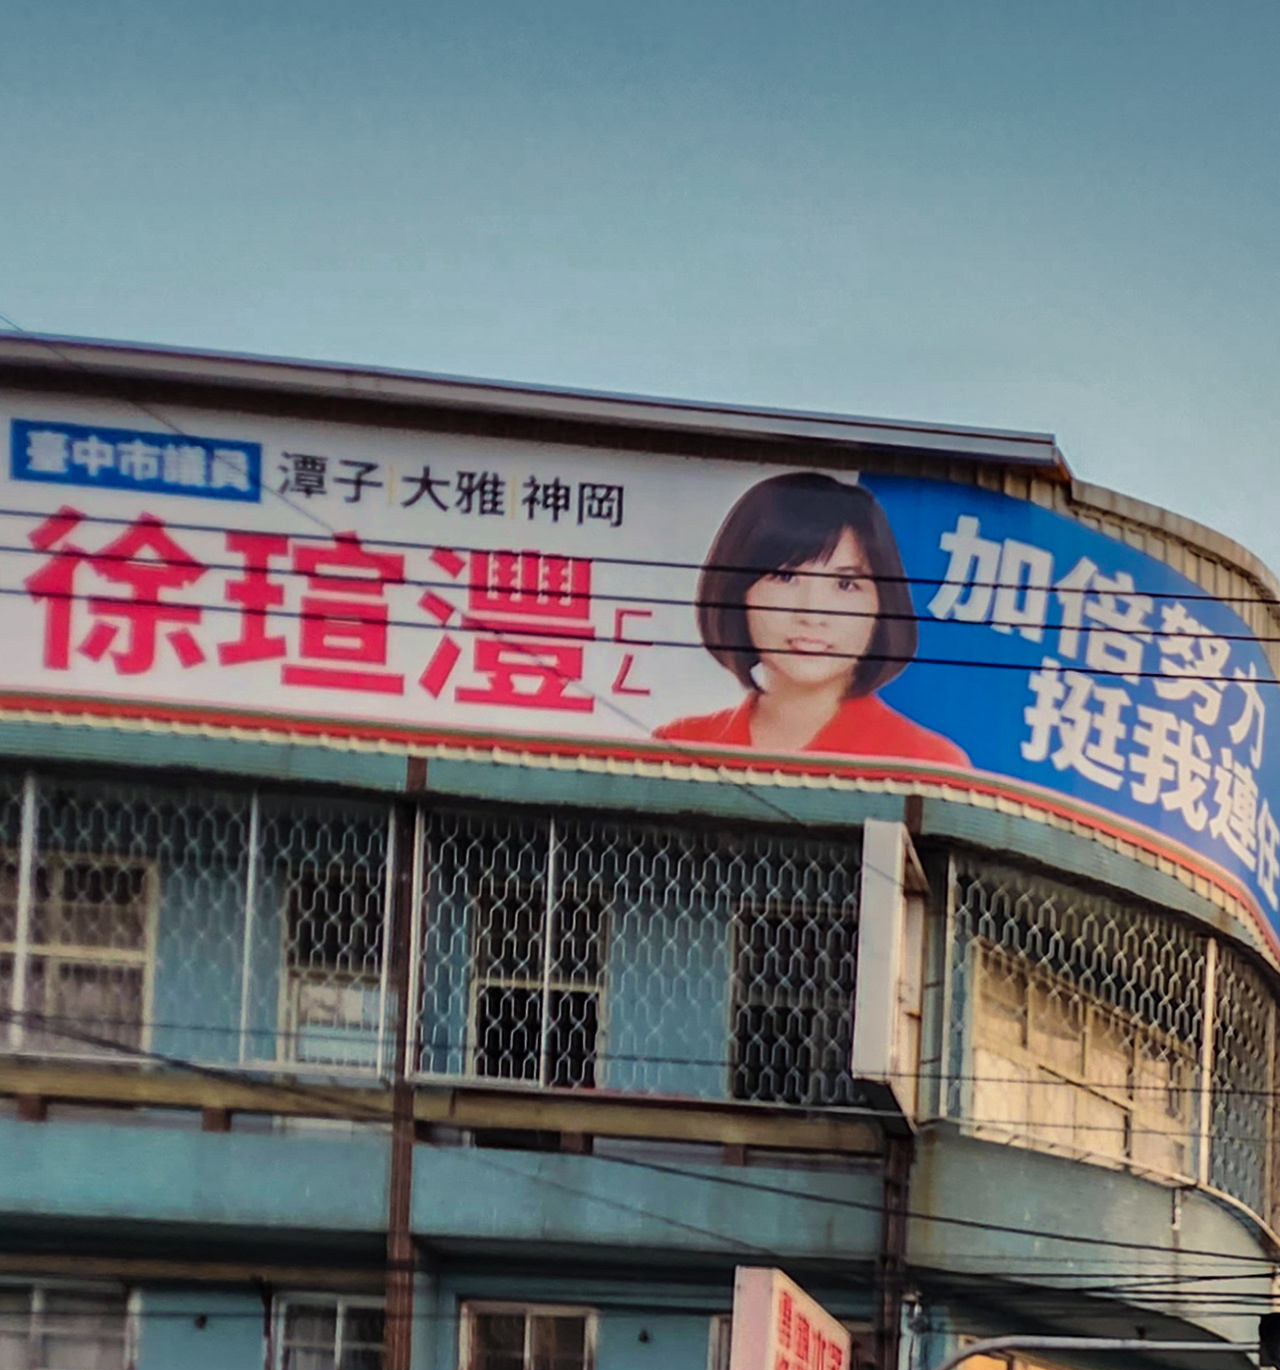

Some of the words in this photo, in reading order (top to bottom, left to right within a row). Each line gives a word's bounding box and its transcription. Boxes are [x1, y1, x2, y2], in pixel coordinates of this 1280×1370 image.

[277, 450, 383, 500] 潭子
[401, 466, 505, 517] 大雅
[521, 477, 624, 526] 神岡
[24, 505, 596, 714] 徐瑄灃
[928, 515, 1267, 769] 加倍努力
[1020, 658, 1280, 910] 挺我連任
